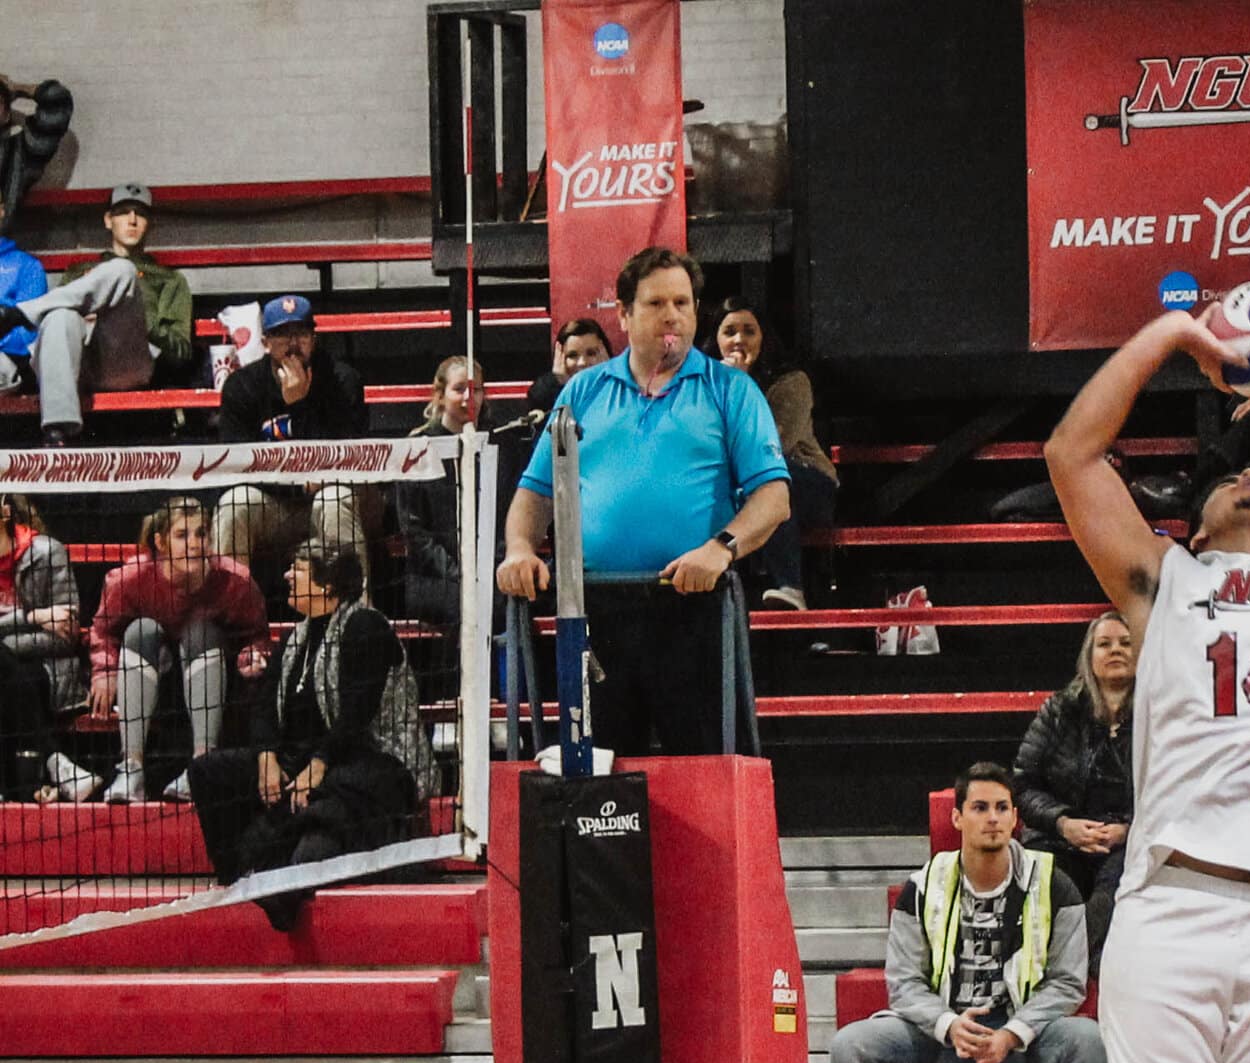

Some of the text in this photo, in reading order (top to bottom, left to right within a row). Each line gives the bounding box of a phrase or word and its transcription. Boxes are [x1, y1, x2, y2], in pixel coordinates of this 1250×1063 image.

[600, 141, 678, 161] MAKE IT
[552, 151, 677, 213] YOURS
[1050, 216, 1157, 248] MAKE
[1166, 214, 1201, 244] IT
[1162, 290, 1198, 303] NCAA
[577, 812, 641, 836] SPALDING
